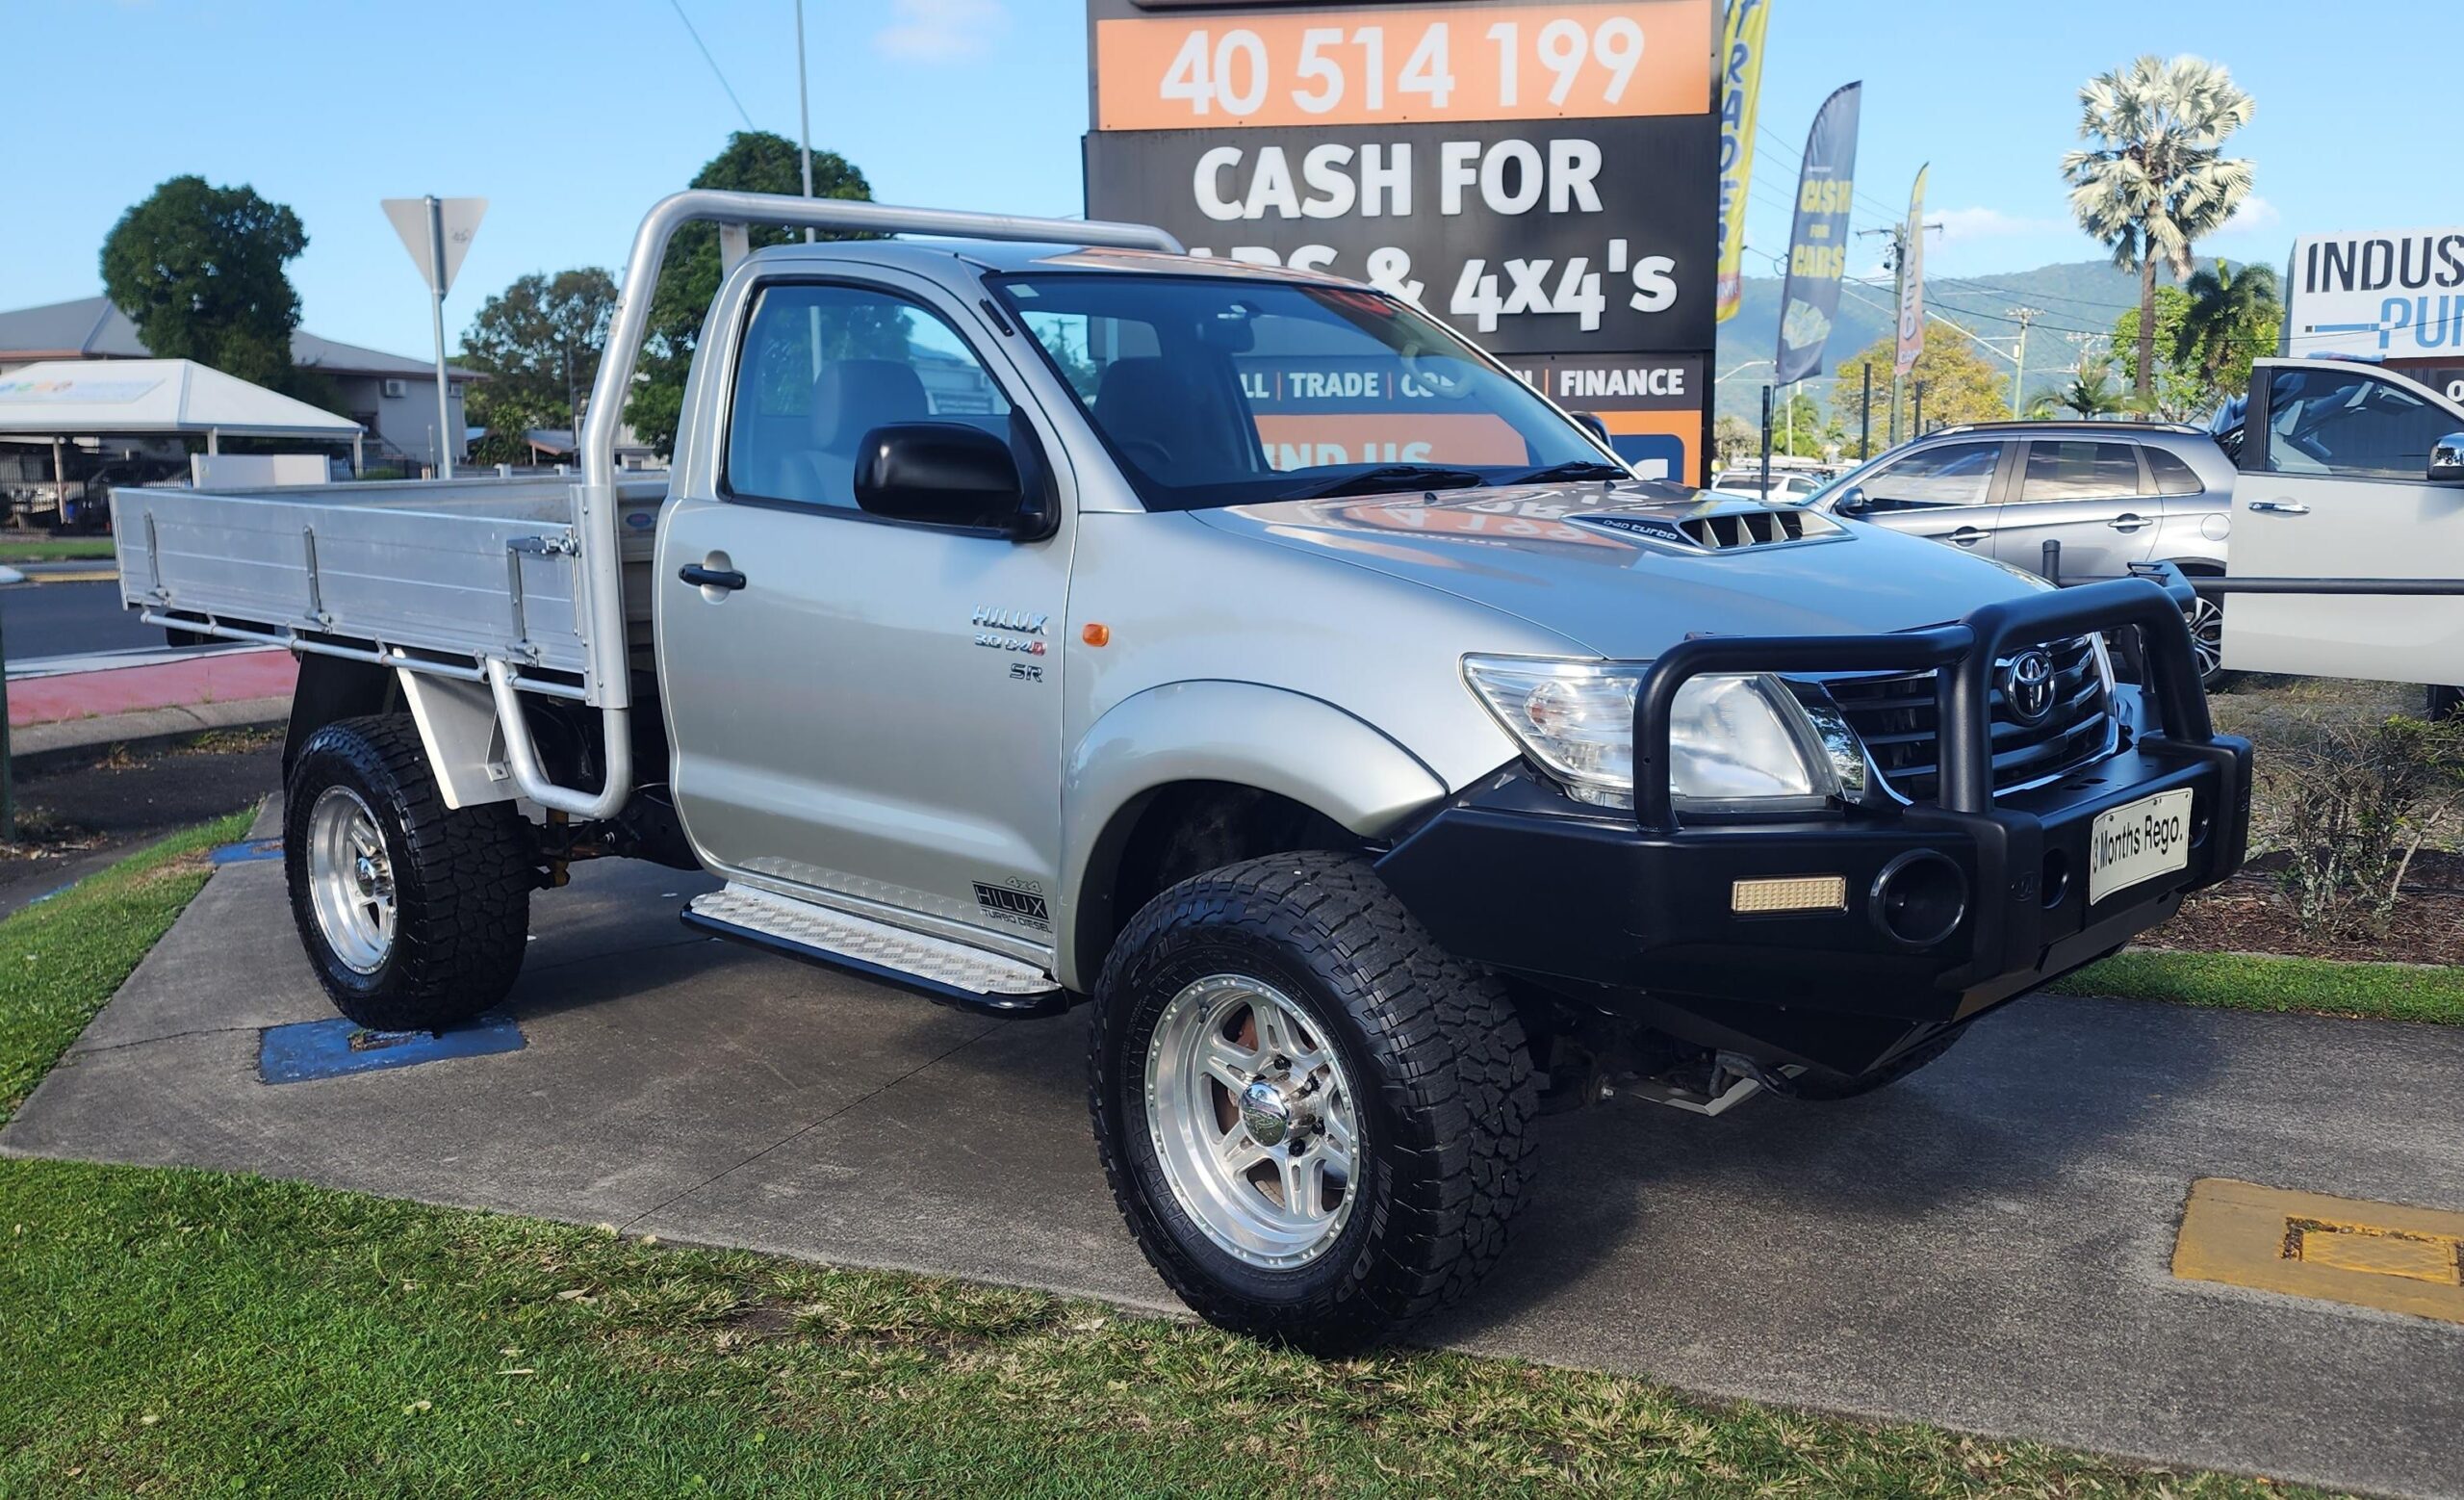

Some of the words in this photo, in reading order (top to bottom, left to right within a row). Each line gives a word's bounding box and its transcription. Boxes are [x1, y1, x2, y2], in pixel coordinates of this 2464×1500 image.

[1160, 29, 1269, 115] 40
[1291, 22, 1454, 114] 514
[1485, 16, 1645, 107] 199
[1194, 142, 1414, 221] CASH
[1441, 139, 1604, 216] FOR
[1290, 372, 1379, 398] TRADE
[1560, 369, 1684, 398] FINANCE
[1630, 524, 1679, 540] turbo
[972, 604, 1048, 636] HILUX
[1009, 662, 1043, 683] SR
[2092, 837, 2099, 874] 3
[2100, 821, 2140, 869] Months
[2144, 814, 2184, 855] Rego.
[974, 885, 1047, 918] HILUX
[980, 908, 1016, 924] TURBO
[1017, 918, 1053, 934] DIESEL
